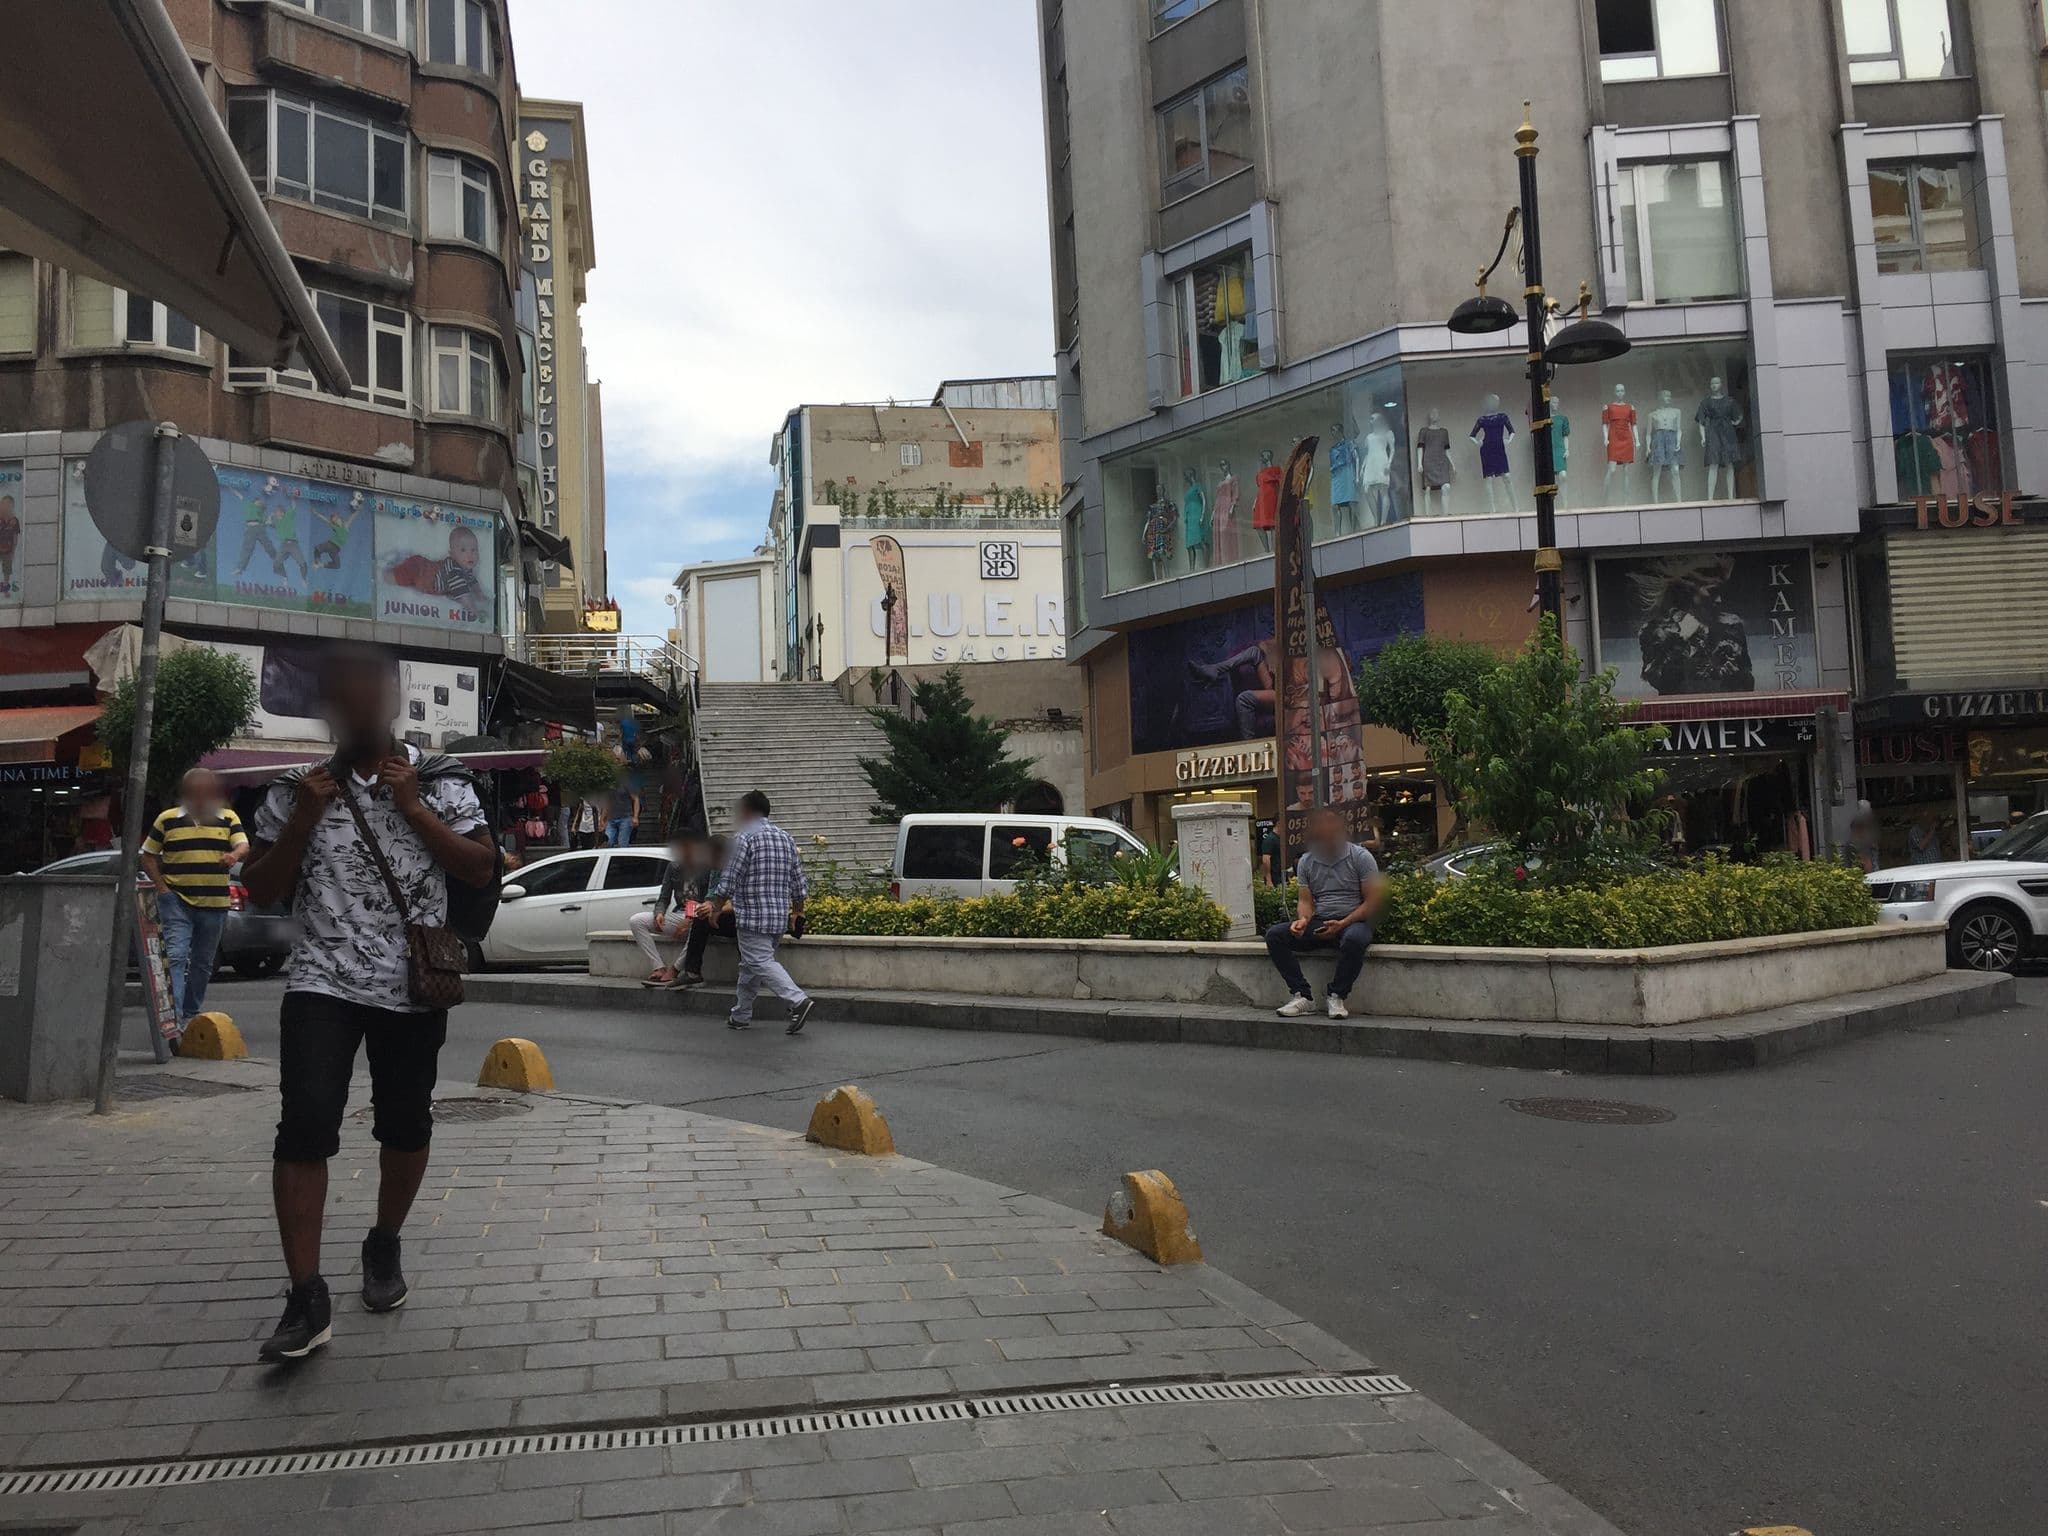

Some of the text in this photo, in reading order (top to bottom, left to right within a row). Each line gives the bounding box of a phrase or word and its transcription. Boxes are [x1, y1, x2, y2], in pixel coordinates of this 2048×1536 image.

[529, 159, 551, 263] GRAND
[540, 466, 557, 571] HOTL
[1908, 491, 2024, 530] TUSE
[984, 543, 1016, 560] GR
[384, 600, 440, 619] JUNIOR
[1768, 563, 1799, 690] KAMER
[1796, 732, 1813, 741] Fur
[30, 766, 70, 780] TIME
